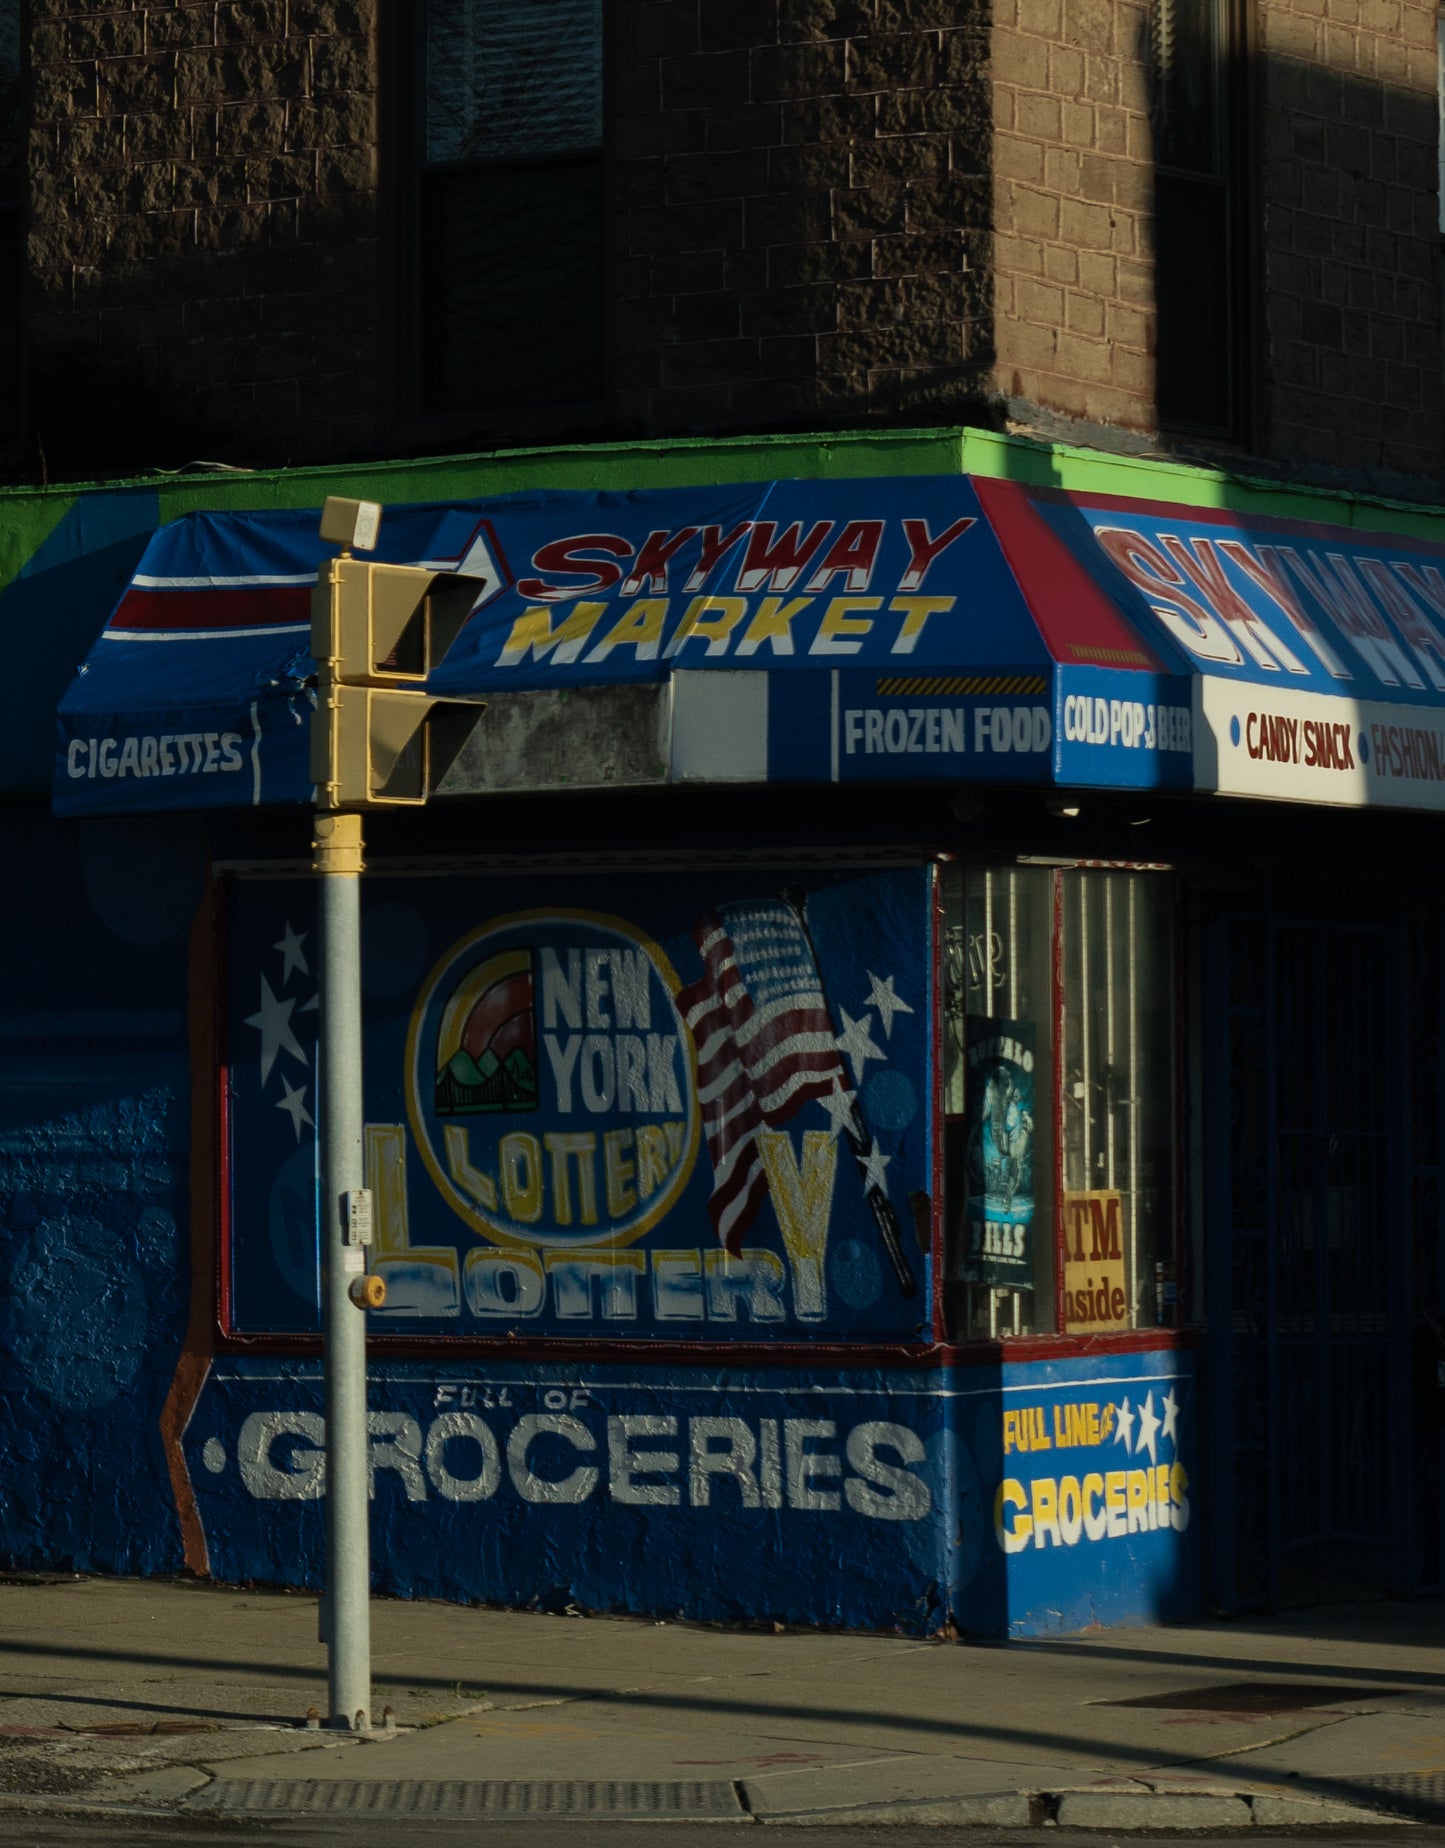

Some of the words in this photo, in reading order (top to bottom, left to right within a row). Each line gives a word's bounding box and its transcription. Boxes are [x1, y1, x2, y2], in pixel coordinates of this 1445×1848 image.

[516, 517, 979, 601] SKYWAY
[493, 596, 958, 667] MARKET
[67, 731, 243, 779] CIGARETTES
[844, 707, 965, 754] FROZEN
[973, 706, 1051, 753] FOOD
[1064, 694, 1109, 744] COLD
[1110, 699, 1145, 748] POP
[1157, 705, 1190, 754] BEER
[1246, 712, 1298, 764] CANDY
[1304, 720, 1355, 770] SNACK
[1370, 723, 1442, 781] FASHION
[541, 946, 652, 1030] NEW
[544, 1033, 683, 1115] YORK
[442, 1120, 686, 1226] LOTTERY
[363, 1122, 838, 1323] LOTTERY
[1064, 1198, 1121, 1262] TM
[433, 1385, 513, 1409] FULL
[544, 1389, 592, 1411] OF
[1003, 1406, 1050, 1455] FULL
[1054, 1402, 1100, 1448] LINE
[238, 1411, 931, 1522] GROCERIES
[994, 1461, 1190, 1553] GROCERIES
